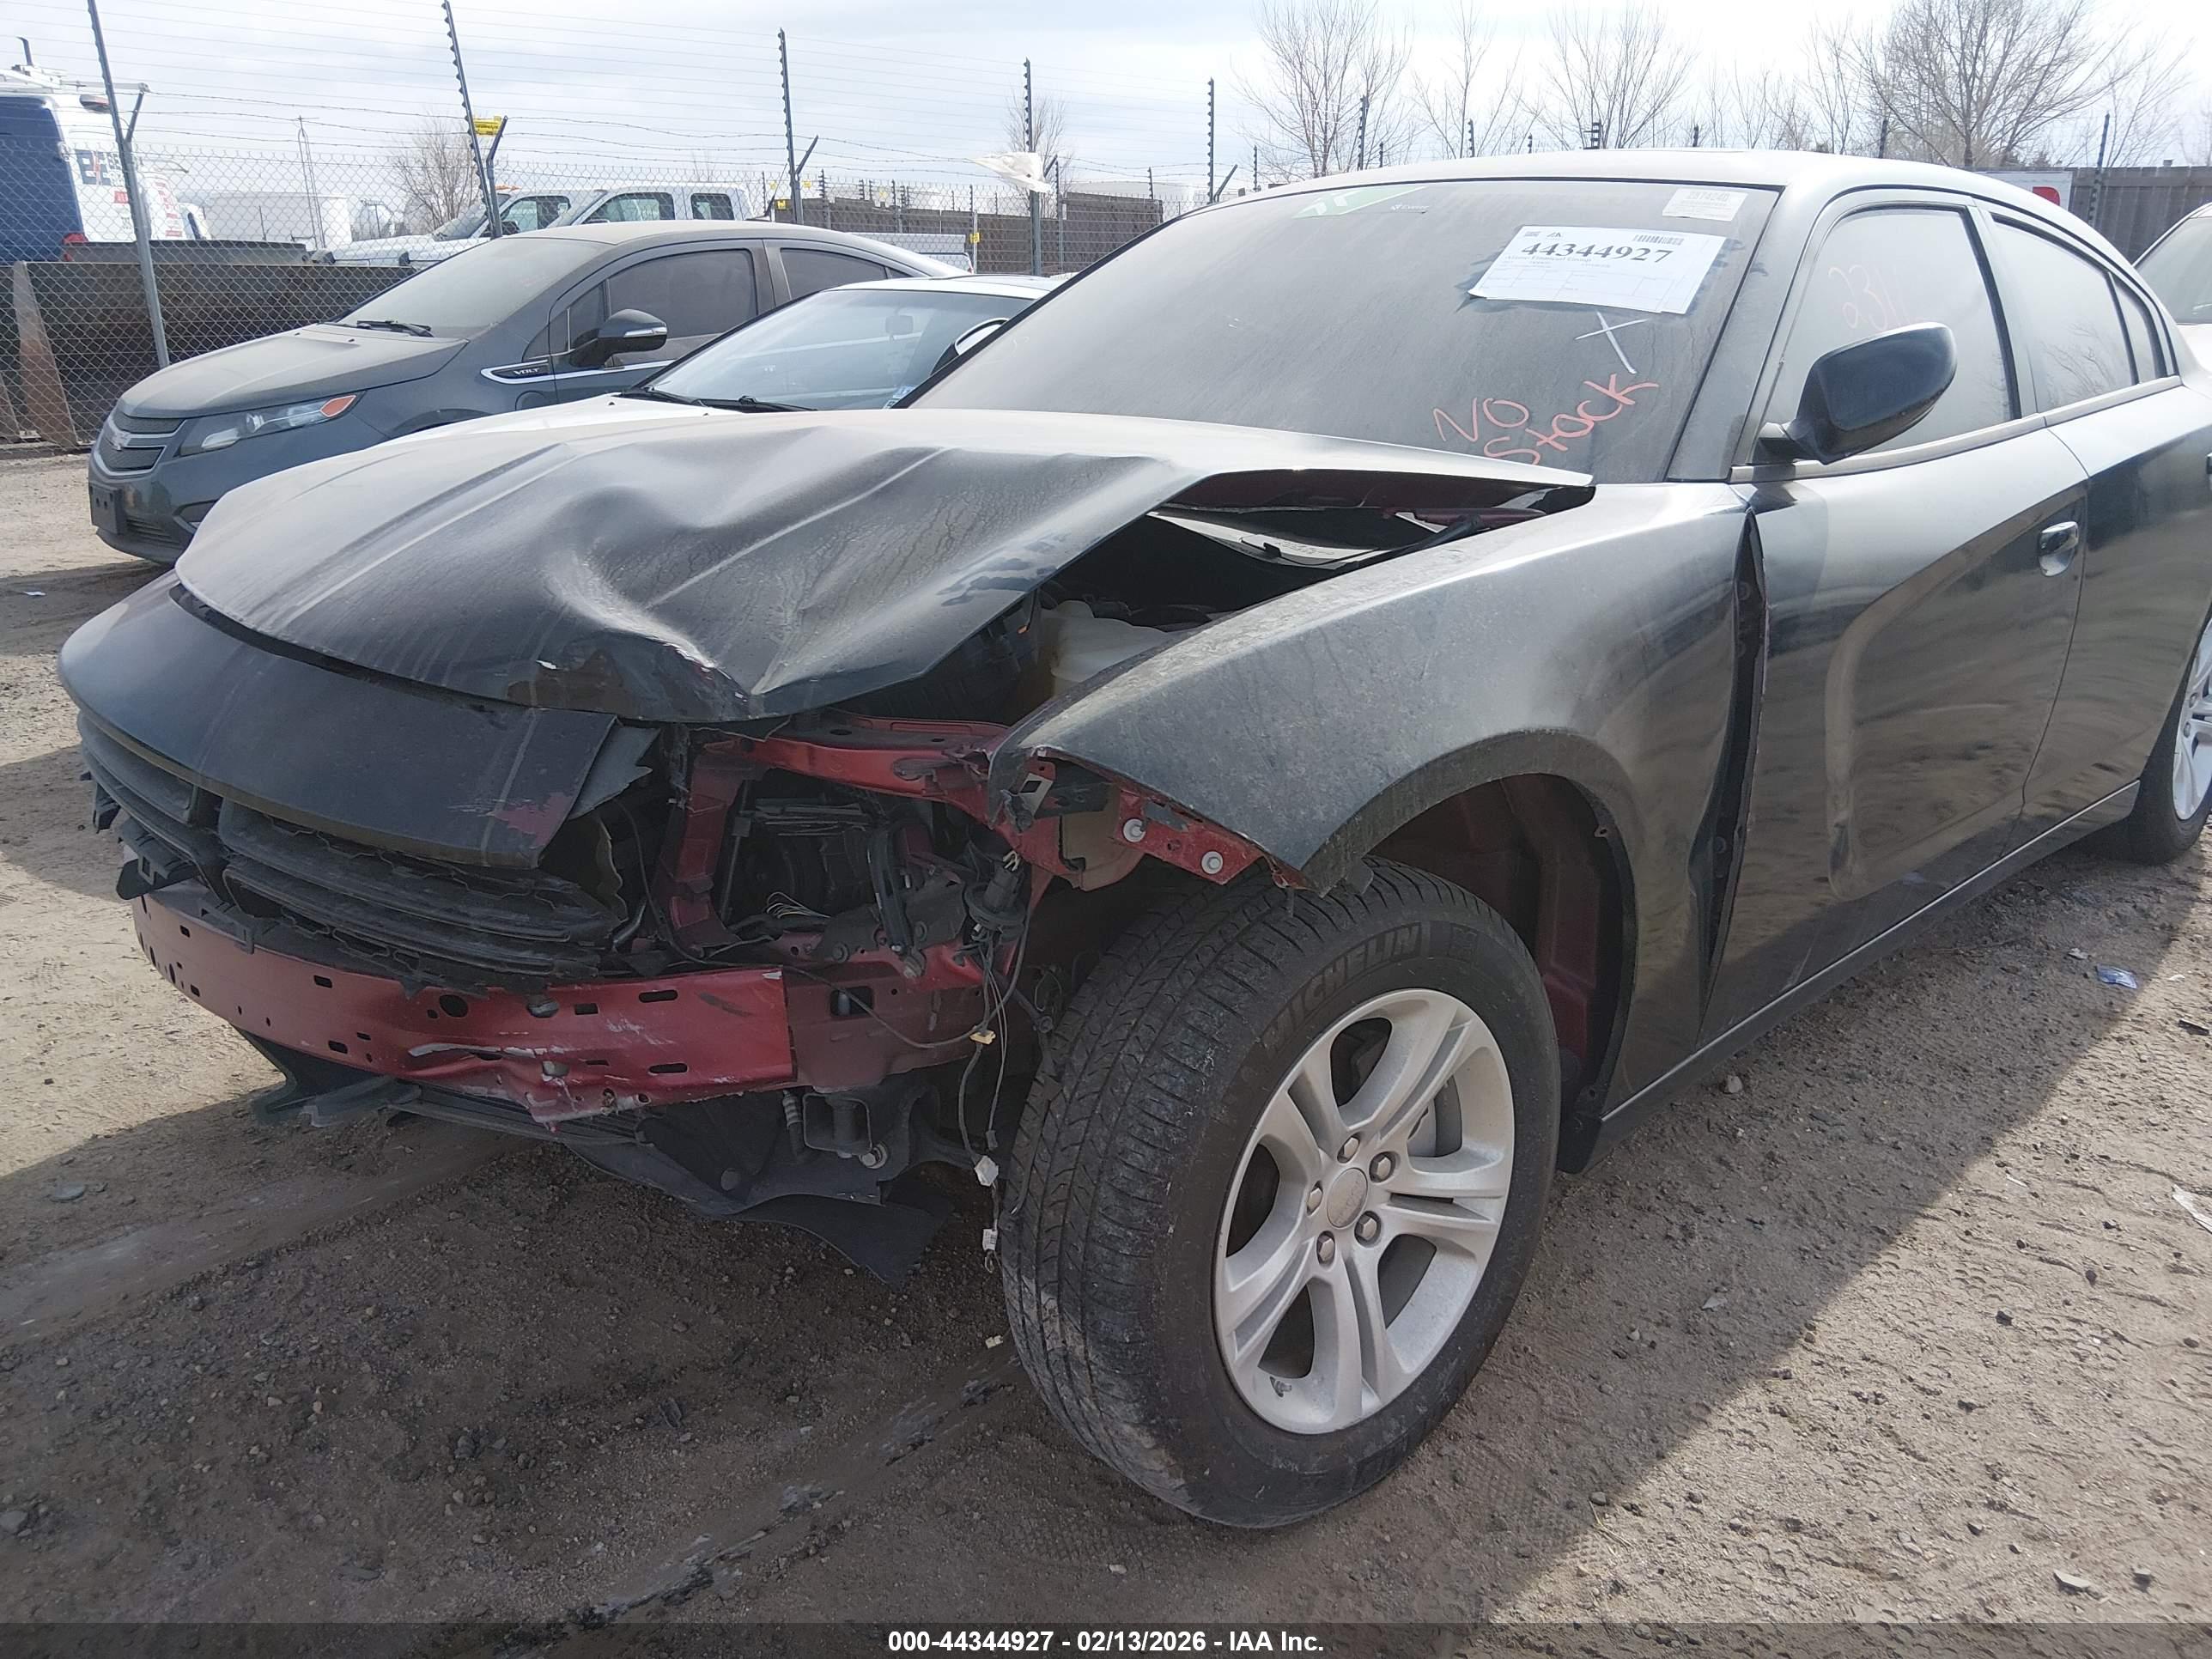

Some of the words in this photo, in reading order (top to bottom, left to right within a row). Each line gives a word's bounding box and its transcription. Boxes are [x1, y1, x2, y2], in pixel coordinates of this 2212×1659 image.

[1522, 242, 1674, 263] 44344927
[1432, 398, 1530, 442] NO
[1261, 921, 1425, 1058] MICHELIN
